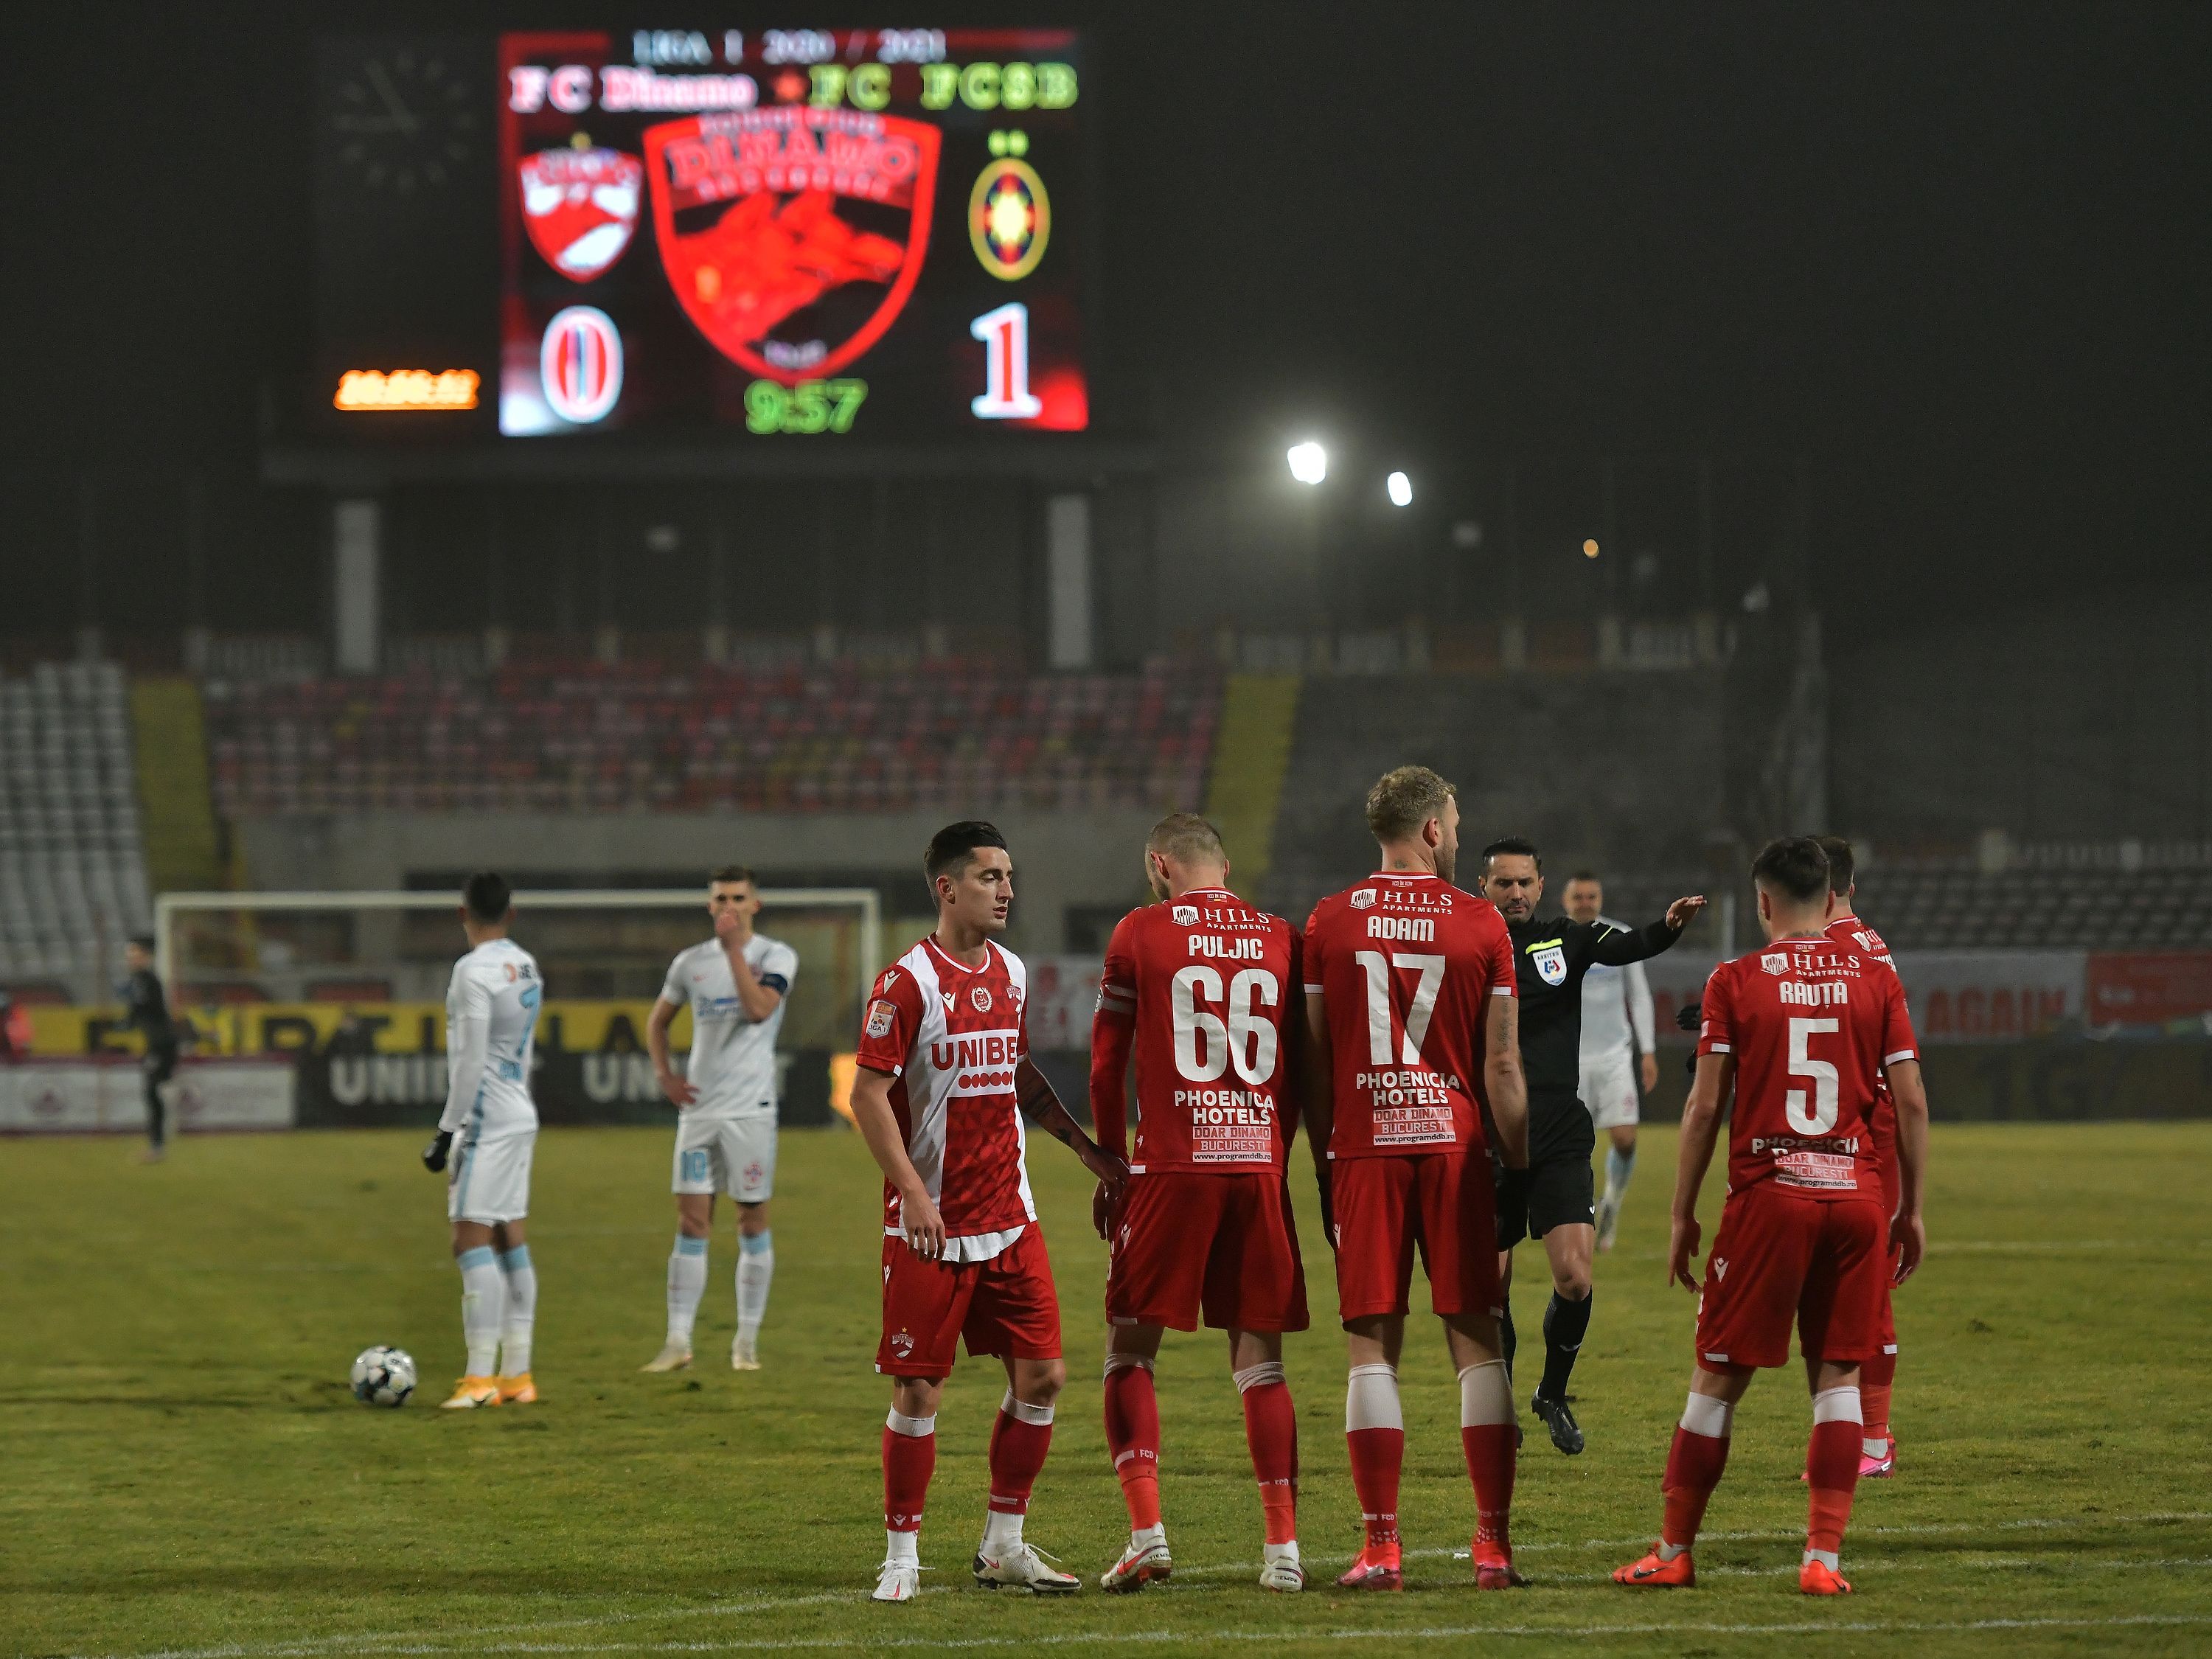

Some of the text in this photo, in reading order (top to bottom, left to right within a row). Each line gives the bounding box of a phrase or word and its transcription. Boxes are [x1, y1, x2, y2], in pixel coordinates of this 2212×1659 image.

[509, 64, 592, 114] FC
[810, 62, 1078, 111] FC FCSB
[540, 305, 625, 424] 0
[970, 301, 1042, 419] 1
[744, 379, 869, 434] 9:57
[1383, 890, 1453, 906] HILS
[1203, 908, 1270, 925] HILS
[1382, 904, 1452, 915] APARTMENTS
[1206, 922, 1272, 933] APARTMENTS
[1368, 916, 1435, 942] ADAM
[1188, 934, 1264, 960] PULJIC
[1792, 953, 1860, 970] HILS
[1796, 969, 1861, 978] APARTMENTS
[1355, 951, 1445, 1065] 17
[1172, 965, 1279, 1085] 66
[931, 1036, 1017, 1071] UNIBE
[1356, 1071, 1460, 1090] PHOENICIA
[1785, 1018, 1840, 1135] 5
[1374, 1088, 1449, 1106] HOTELS
[1193, 1108, 1271, 1124] HOTELS
[1375, 1107, 1451, 1121] DOAR DINAMO
[1194, 1127, 1269, 1138] DOAR DINAMO
[1382, 1121, 1447, 1134] BUCURESTI
[1200, 1141, 1265, 1152] BUCURESTI
[1375, 1134, 1455, 1144] www.programddb.ro
[1194, 1152, 1271, 1161] www.programddb.ro
[1139, 1449, 1154, 1459] FCD
